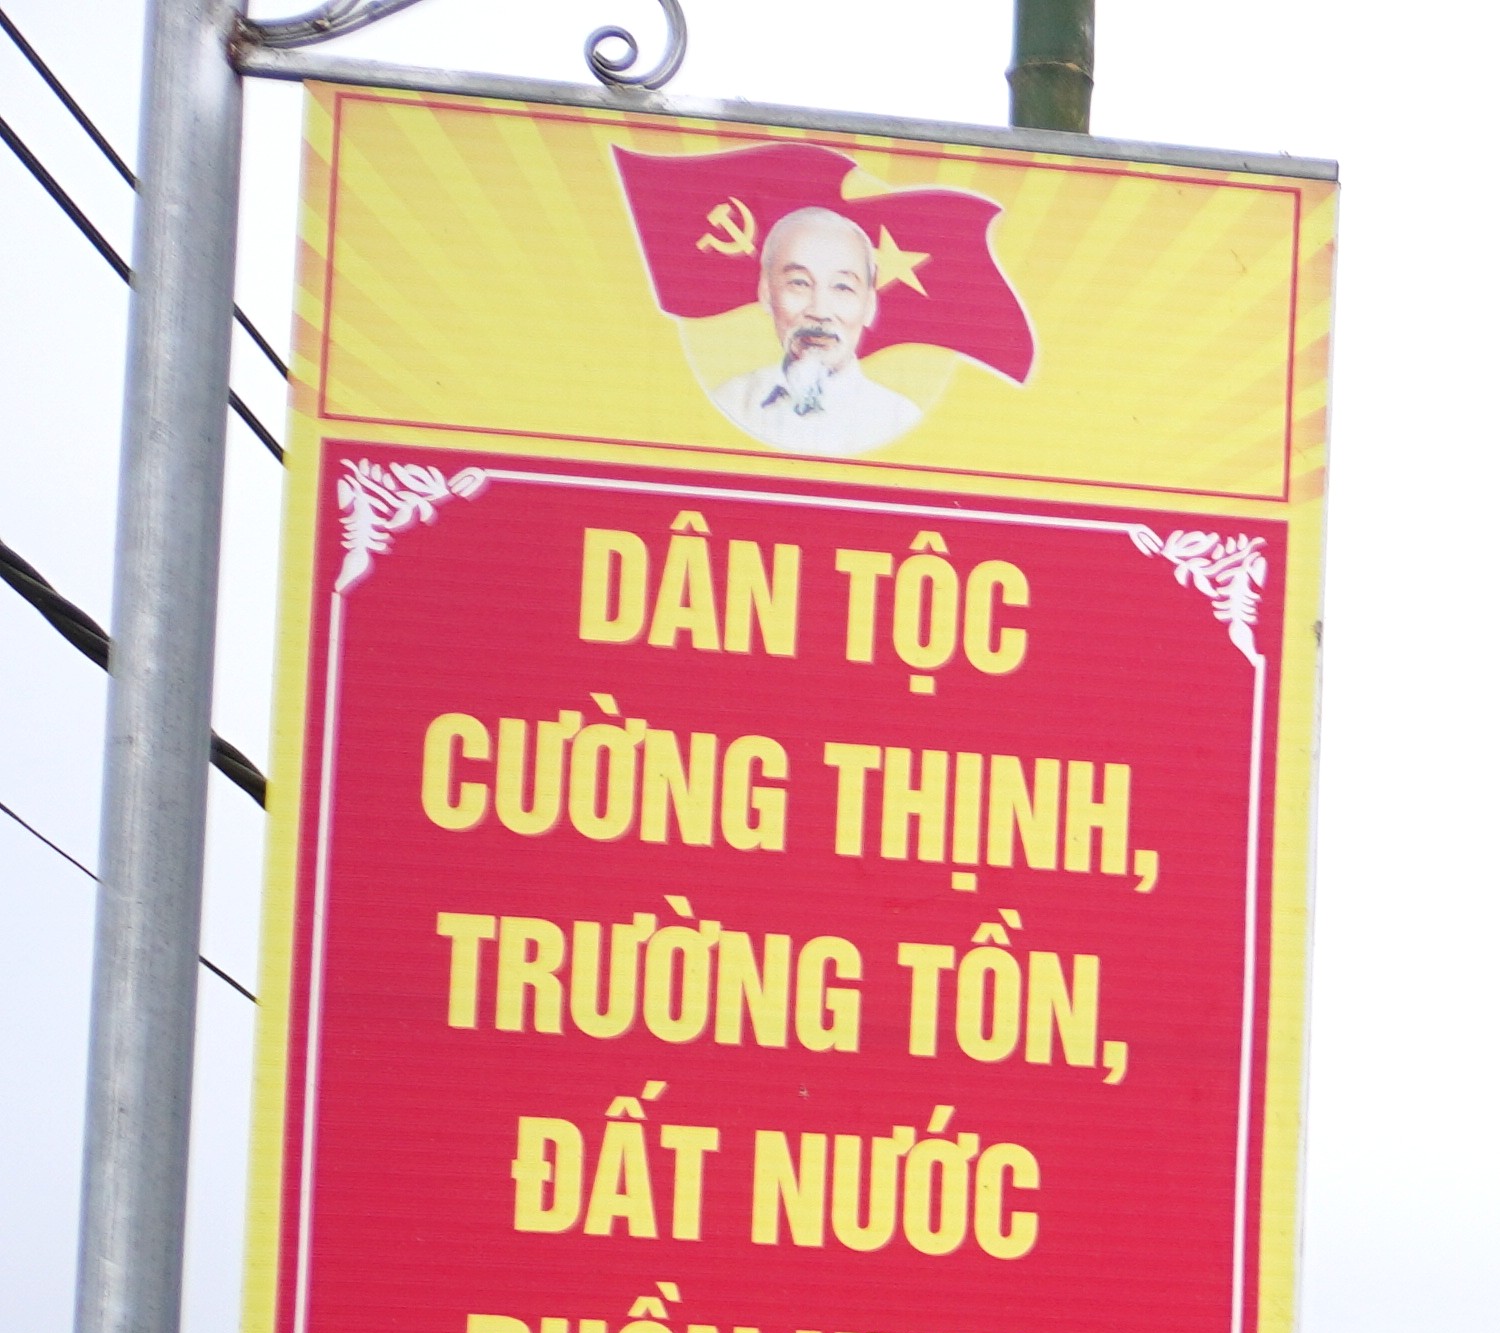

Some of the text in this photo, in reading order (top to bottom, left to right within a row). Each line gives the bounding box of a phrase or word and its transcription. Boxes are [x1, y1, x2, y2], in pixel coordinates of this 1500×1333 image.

[580, 511, 1028, 694] DÂN TỘC
[422, 693, 1157, 892] CƯỜNG THỊNH,
[437, 896, 1127, 1084] TRƯỜNG TỒN,
[512, 1081, 1039, 1259] ĐẤT NƯỚC
